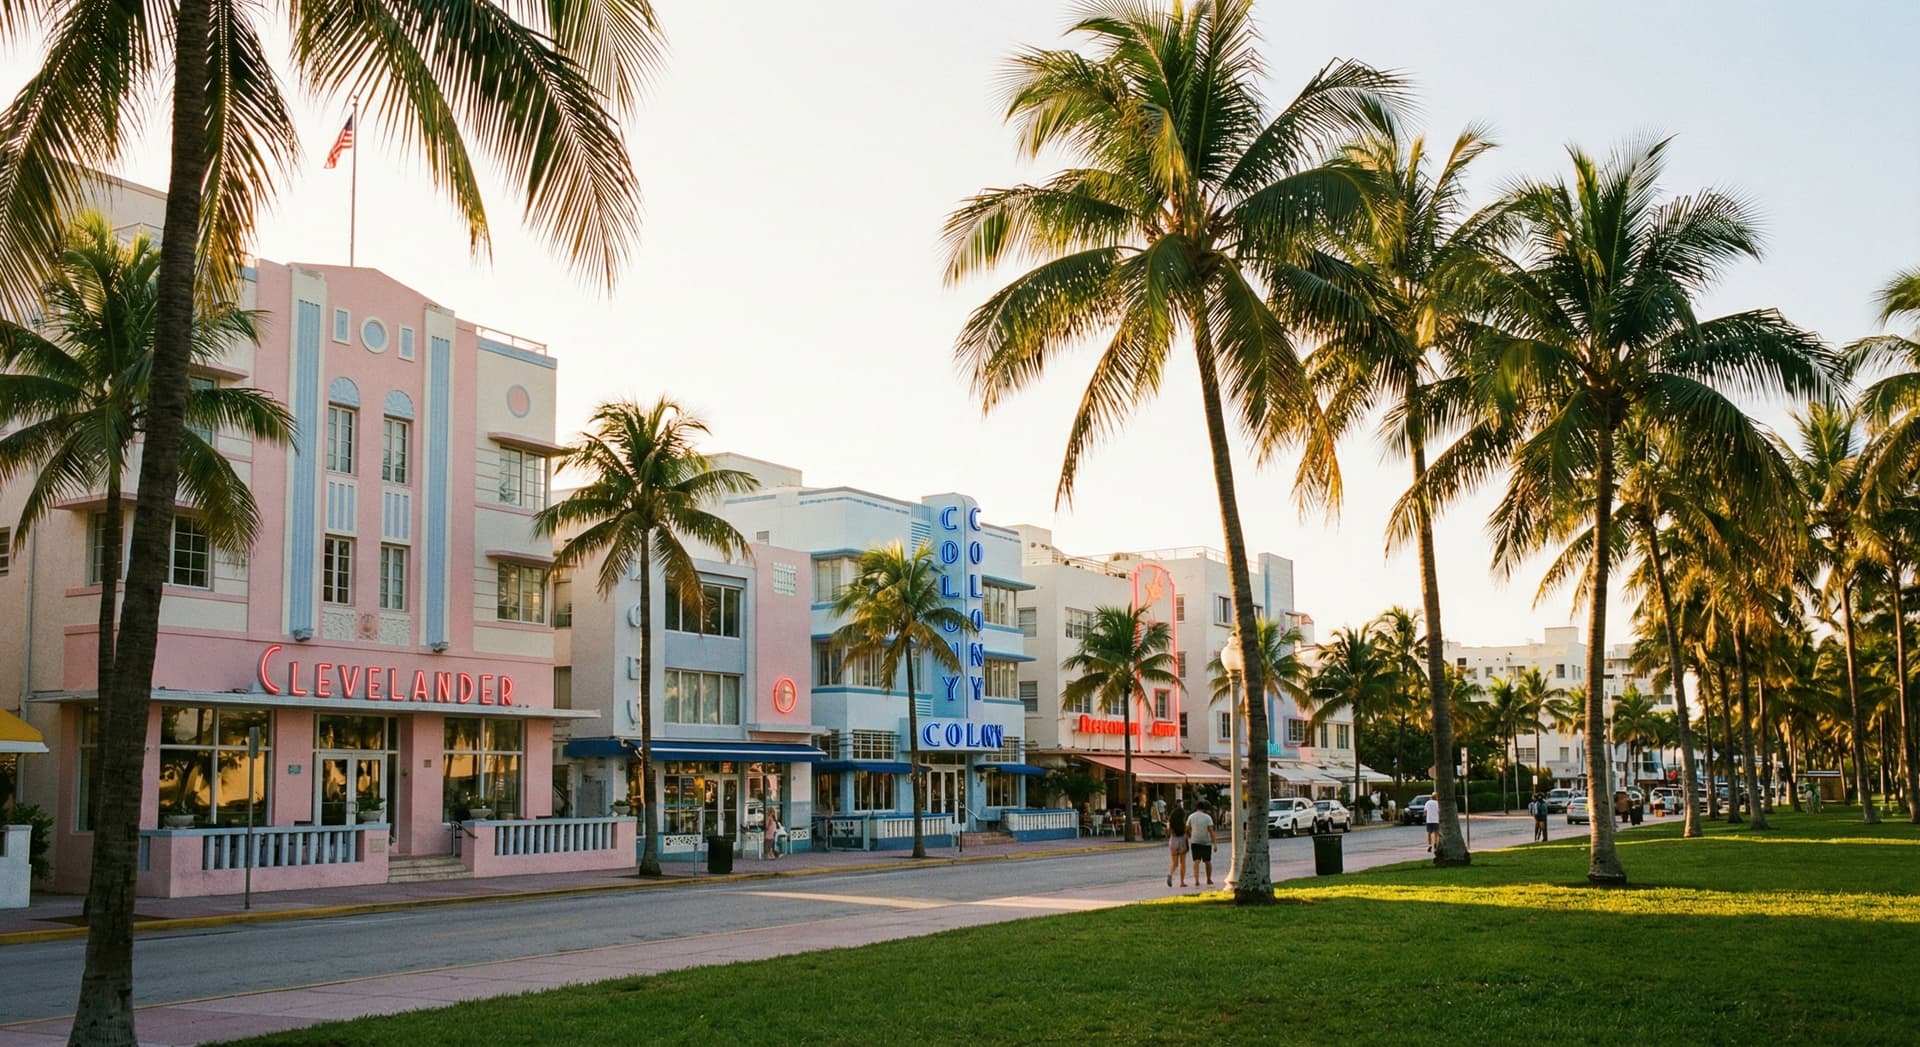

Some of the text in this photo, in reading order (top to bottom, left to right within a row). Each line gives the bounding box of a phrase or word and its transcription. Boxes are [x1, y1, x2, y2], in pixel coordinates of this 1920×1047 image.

[258, 644, 513, 706] CLEVELANDER
[941, 506, 959, 701] COLY
[969, 506, 984, 701] COLONY
